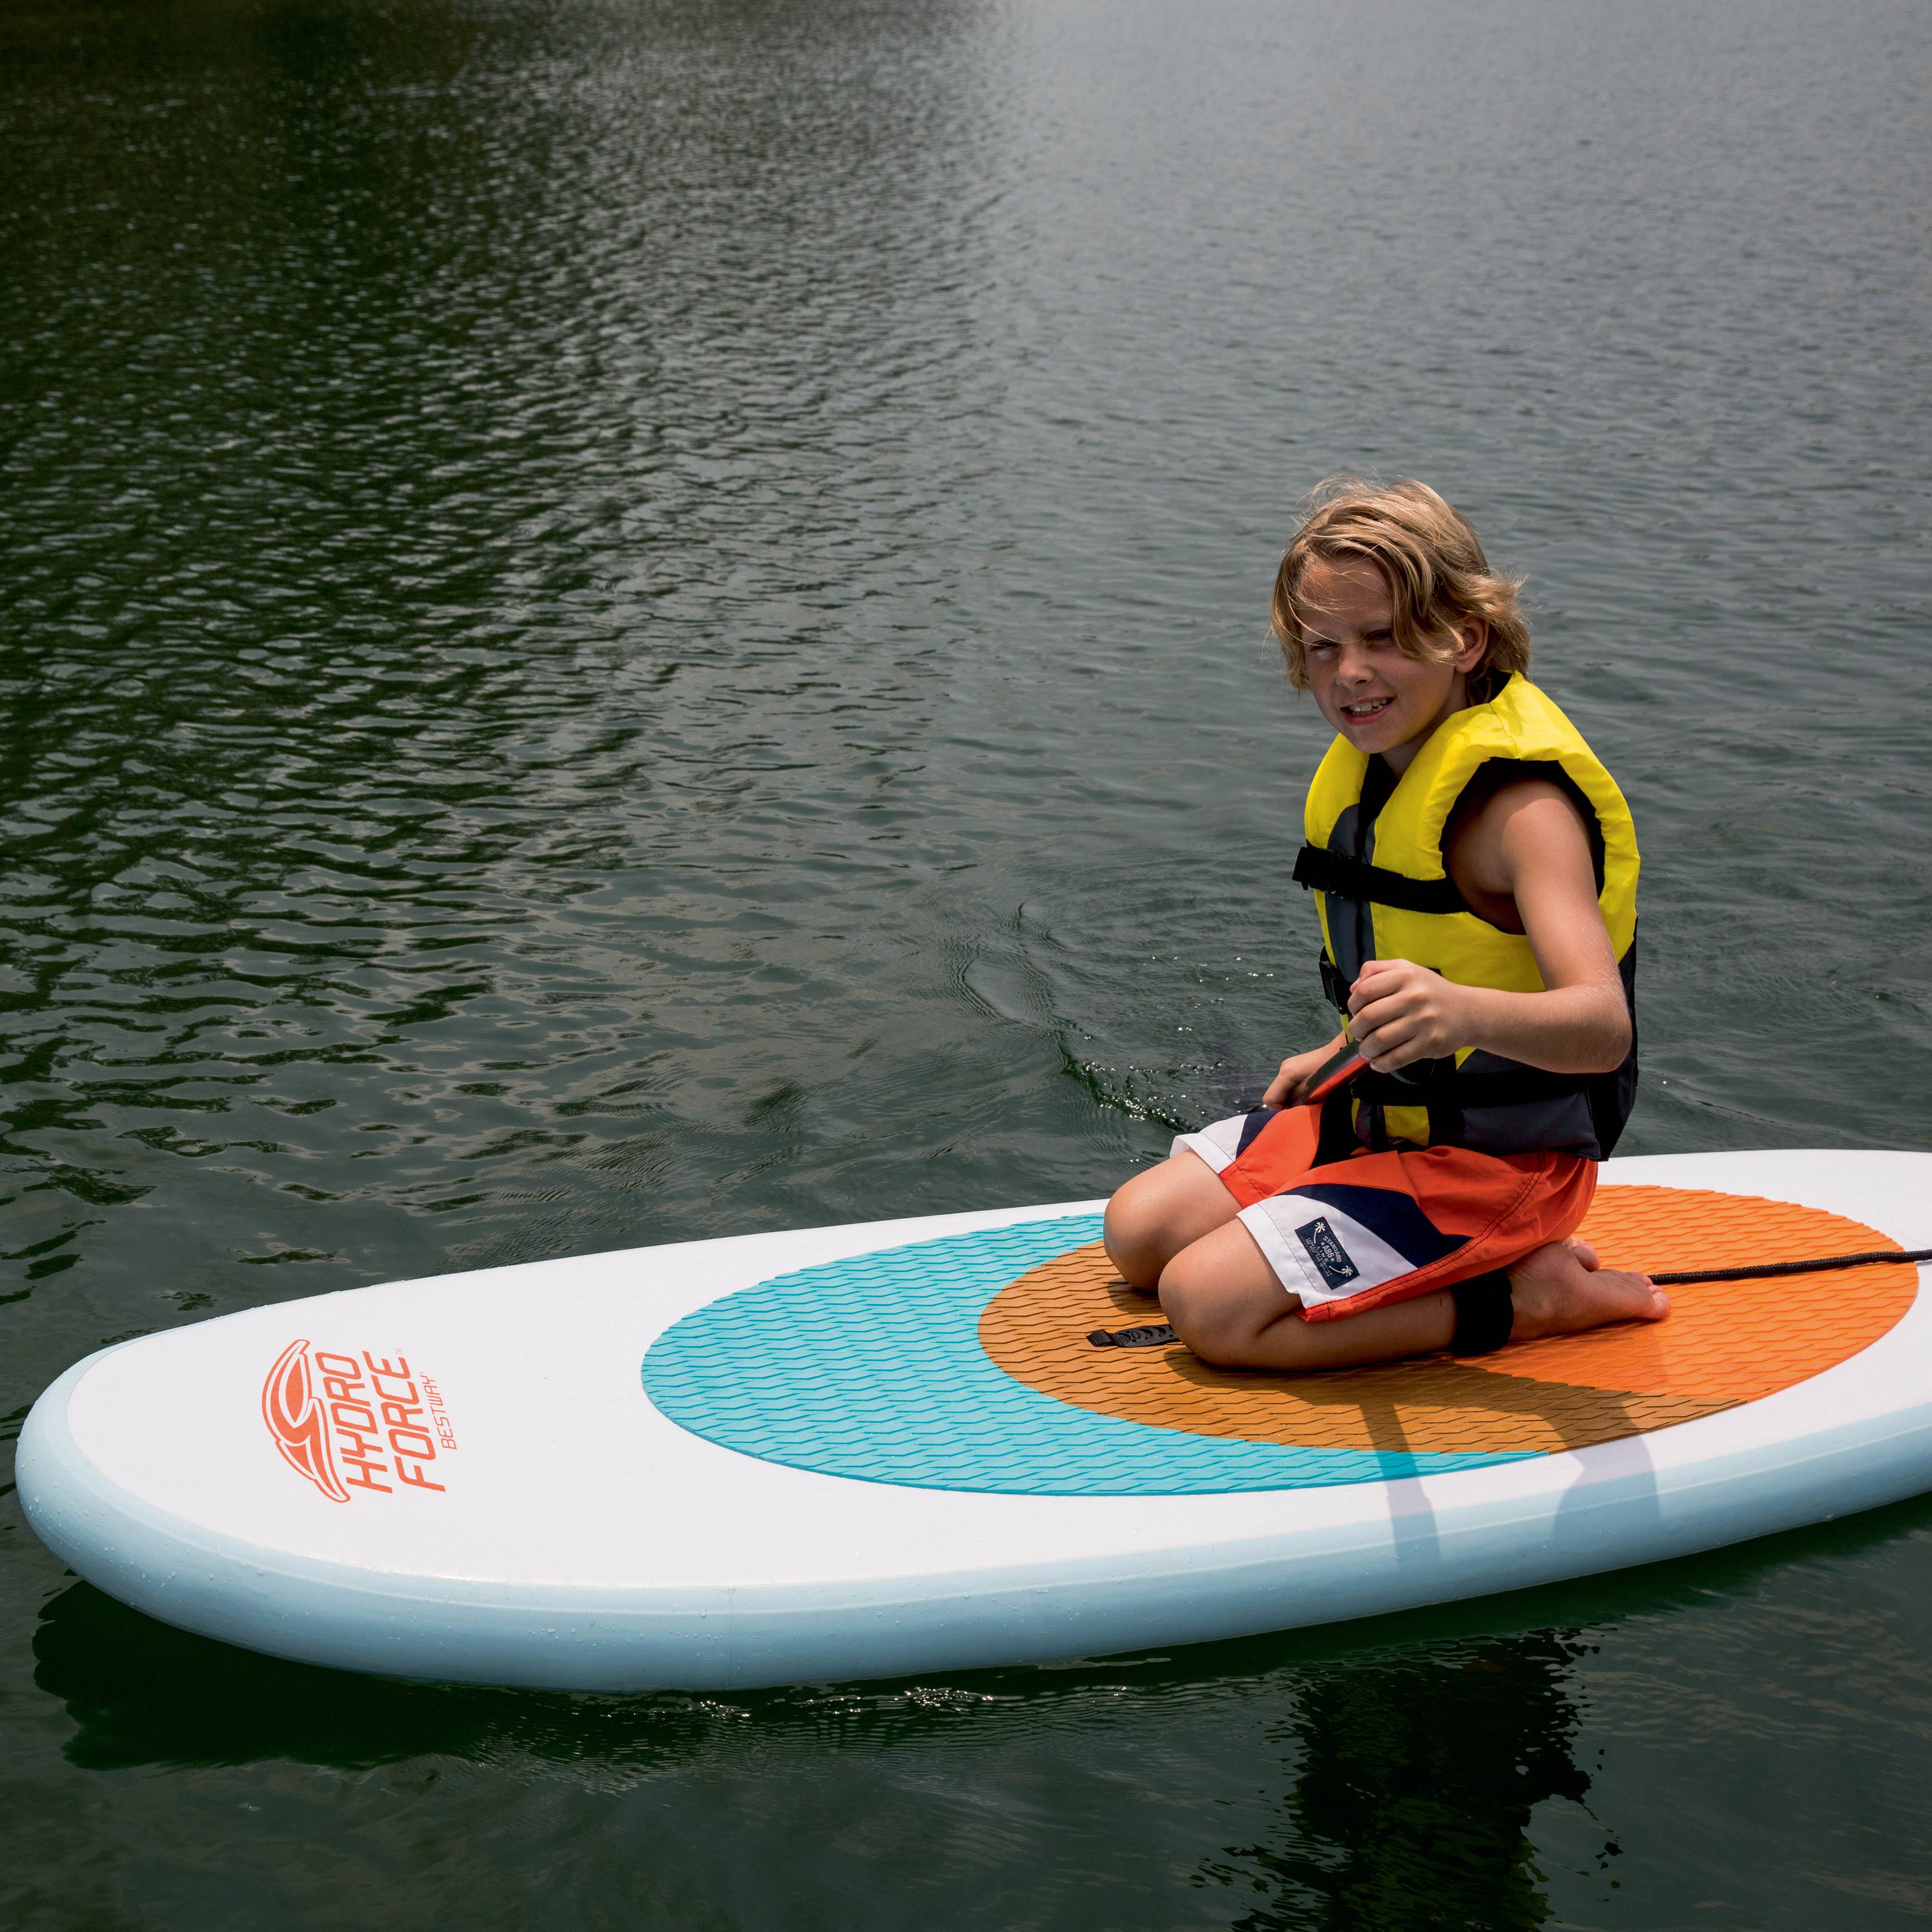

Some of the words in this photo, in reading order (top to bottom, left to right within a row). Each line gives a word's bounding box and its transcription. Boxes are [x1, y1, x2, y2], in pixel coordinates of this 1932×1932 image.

[1317, 1246, 1329, 1262] LINE
[1321, 1245, 1335, 1259] A86
[1323, 1236, 1341, 1262] STANDARD
[315, 1352, 393, 1494] HYDRO
[362, 1350, 446, 1492] FORCE
[422, 1375, 457, 1450] BESTWAY
